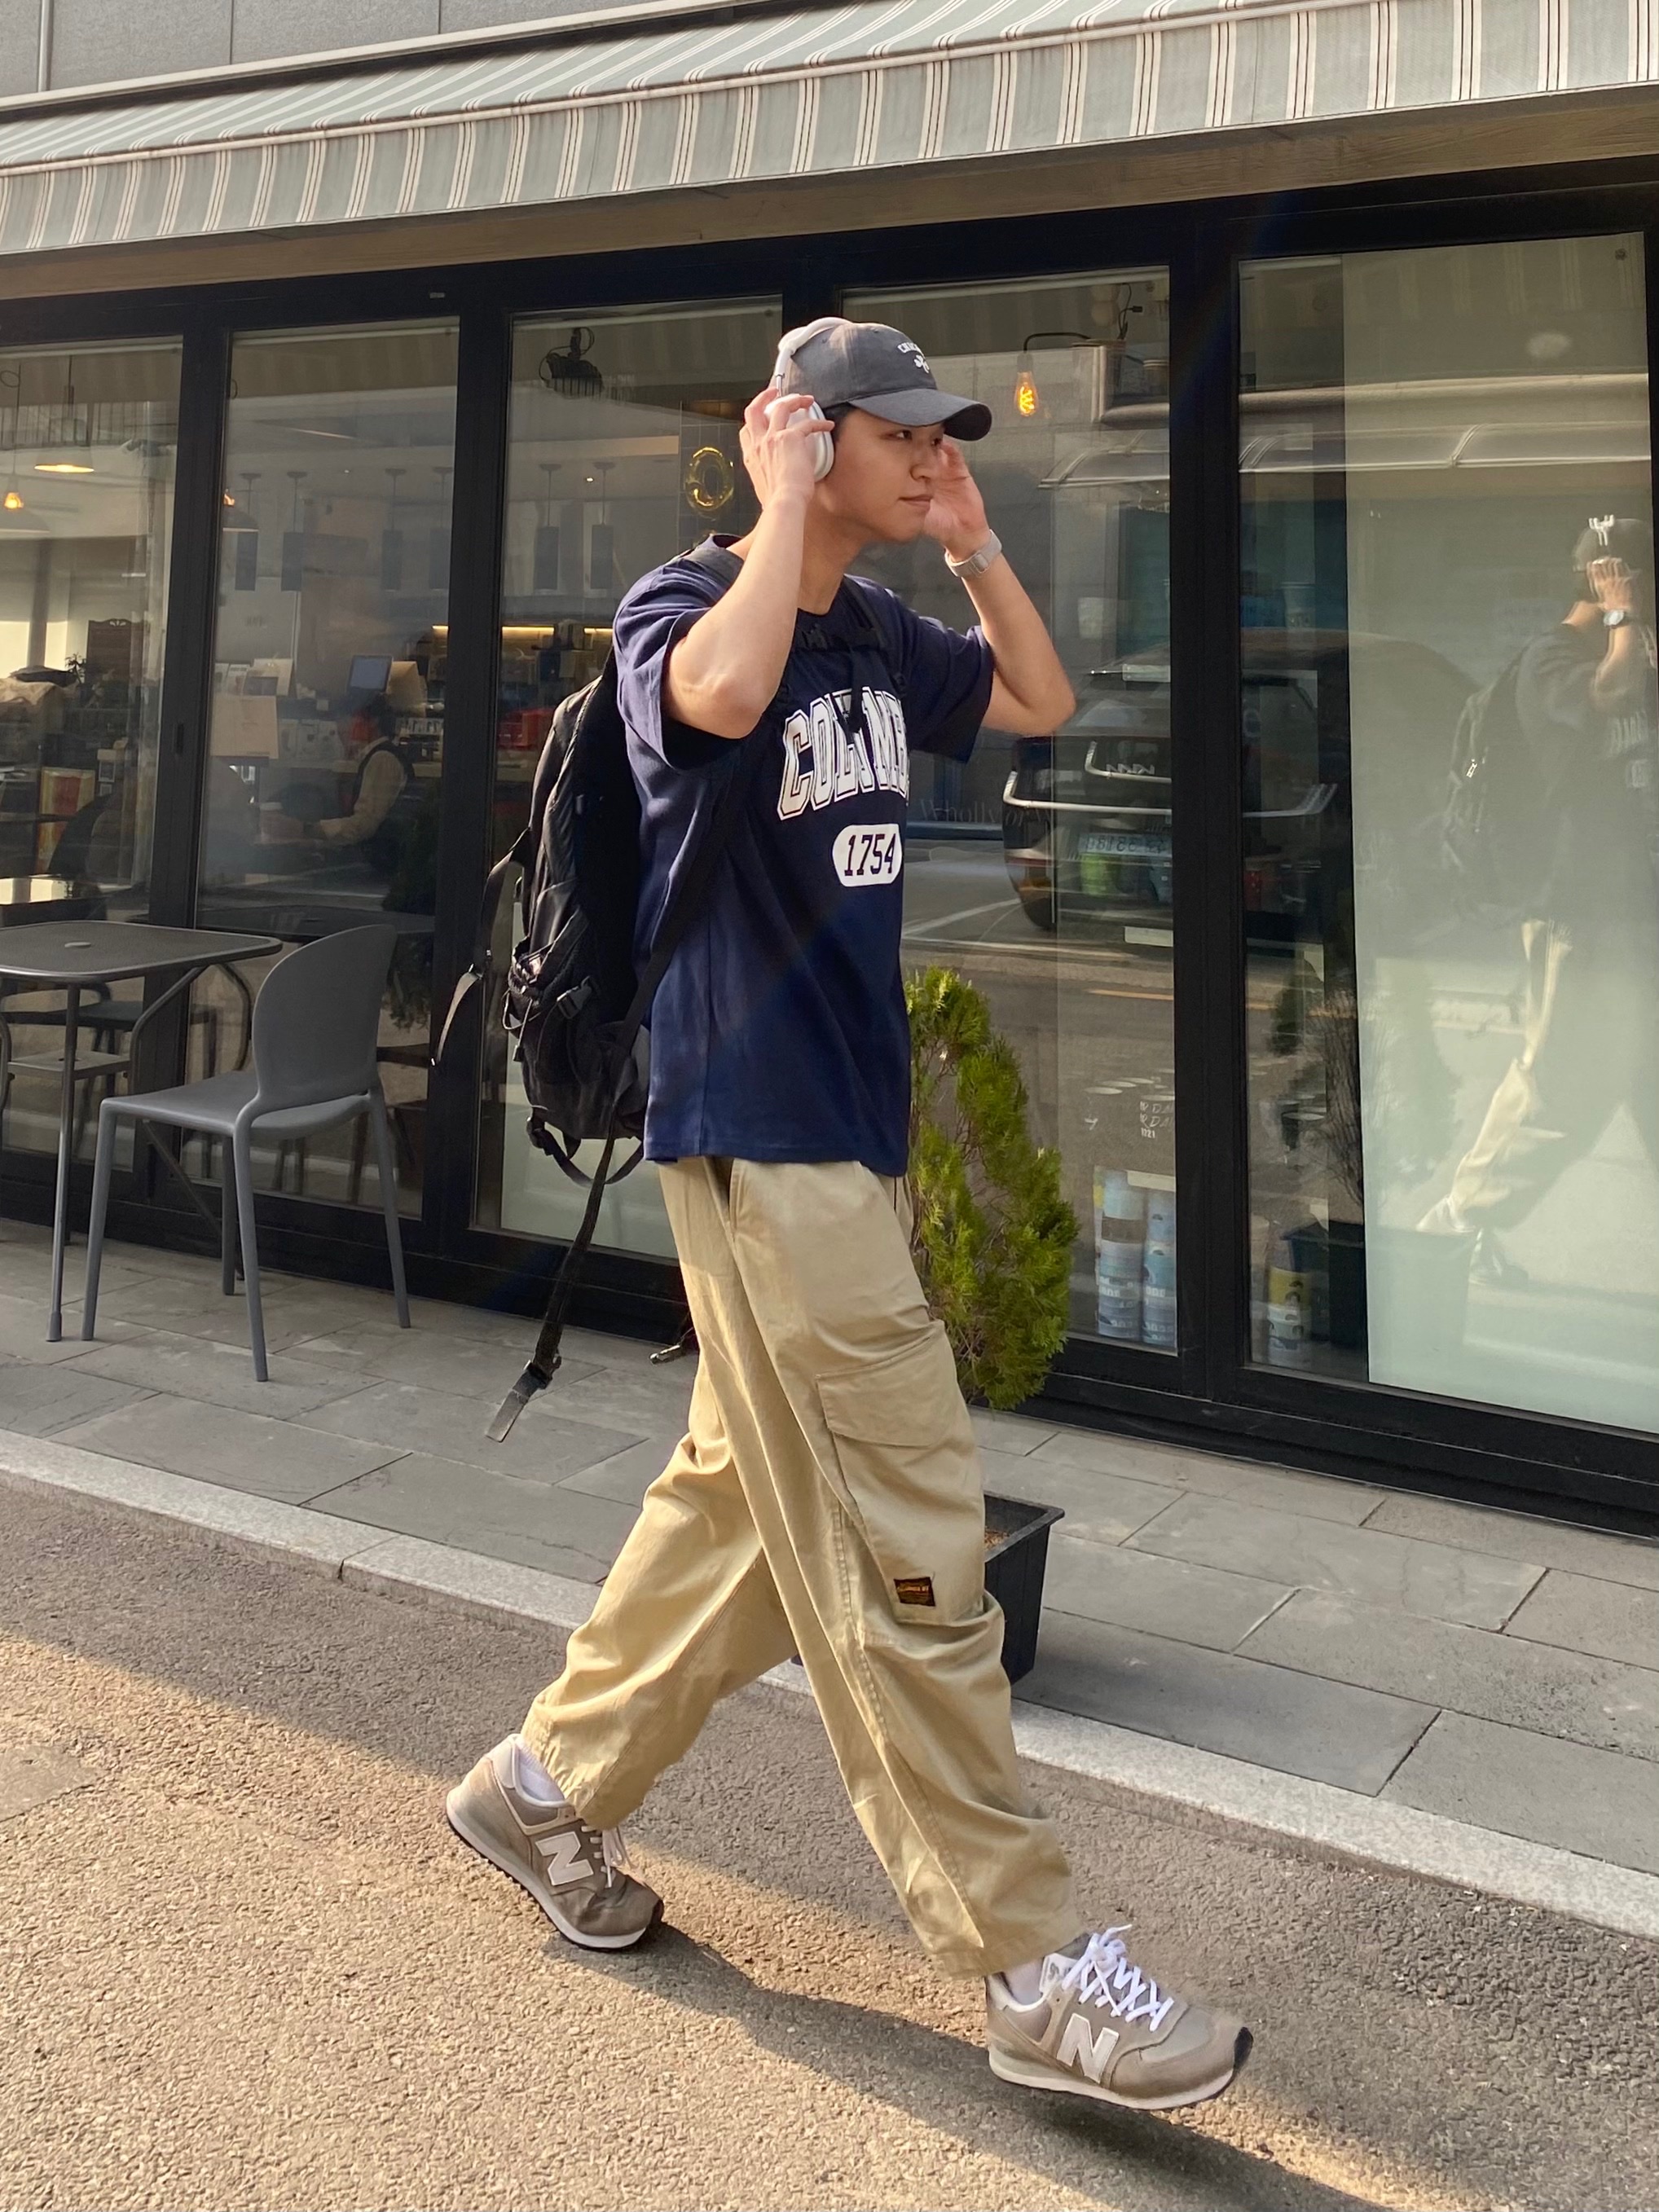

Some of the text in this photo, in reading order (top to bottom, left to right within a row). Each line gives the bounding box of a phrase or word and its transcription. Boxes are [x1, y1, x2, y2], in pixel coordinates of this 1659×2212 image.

[844, 833, 897, 877] 1754
[535, 1832, 593, 1885] N
[1057, 2013, 1119, 2083] N
